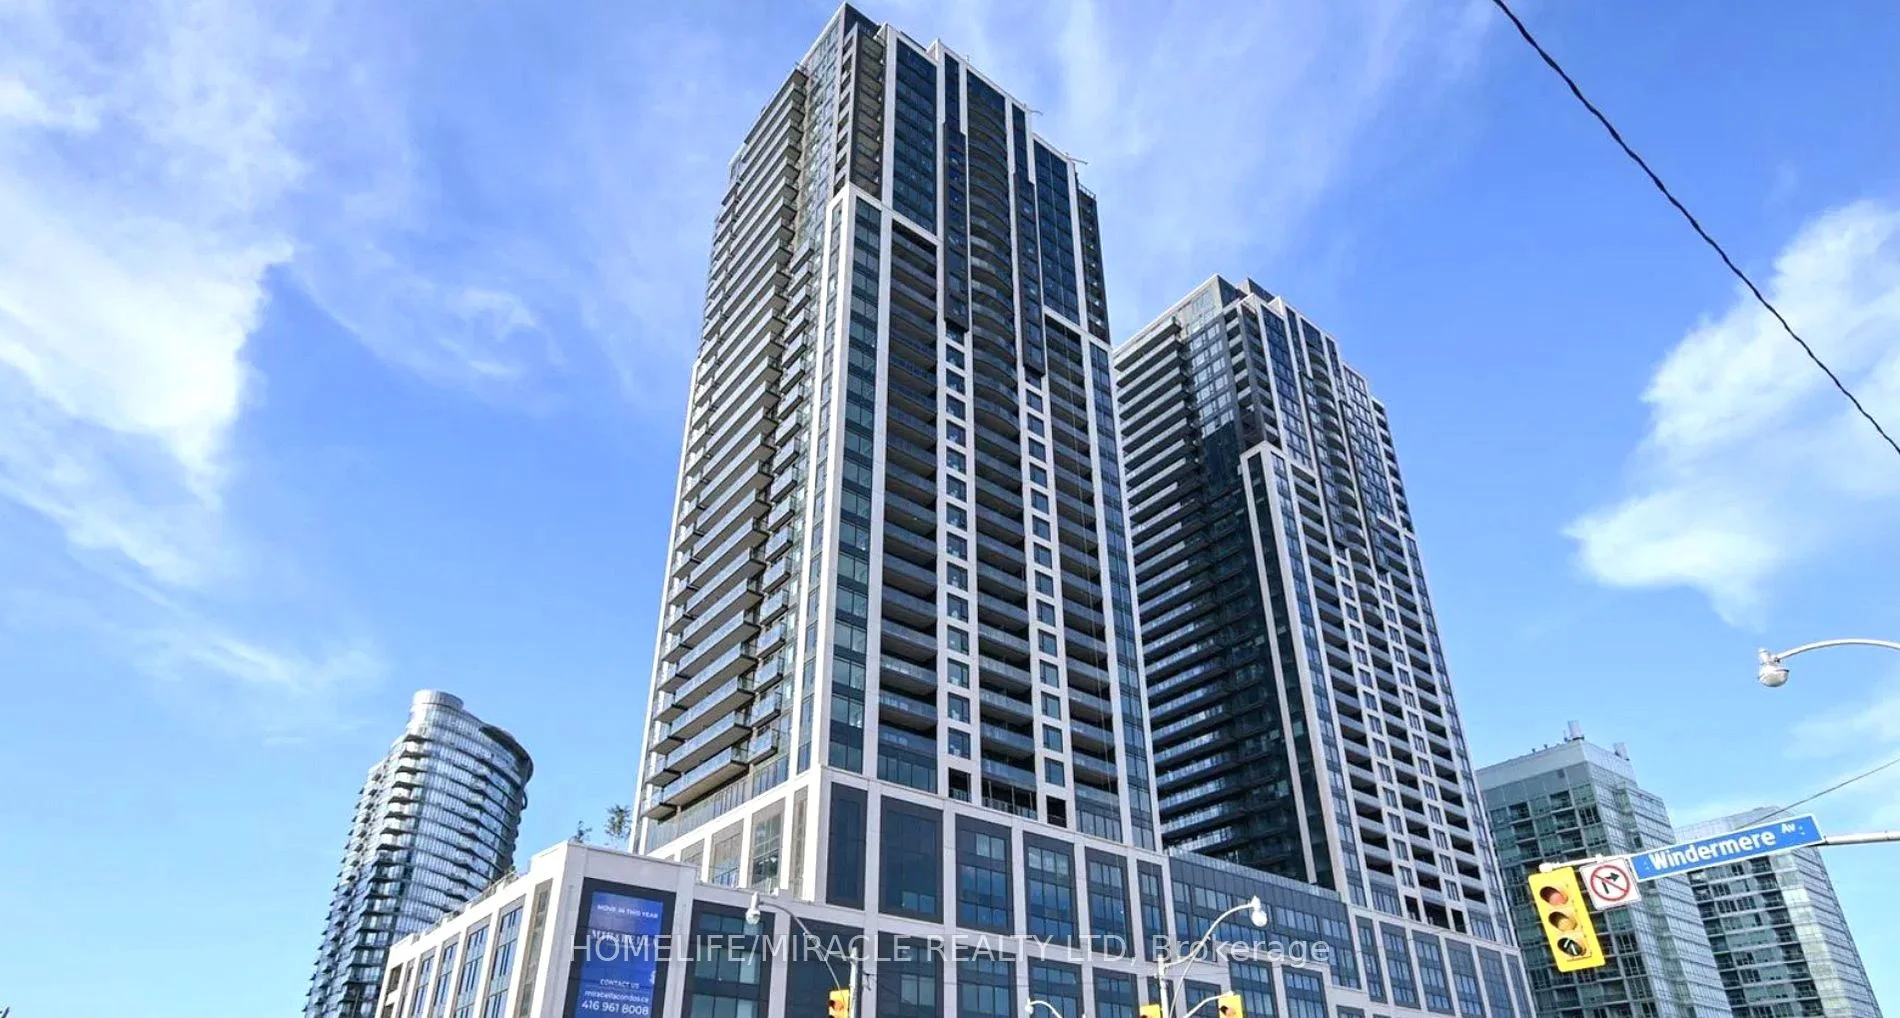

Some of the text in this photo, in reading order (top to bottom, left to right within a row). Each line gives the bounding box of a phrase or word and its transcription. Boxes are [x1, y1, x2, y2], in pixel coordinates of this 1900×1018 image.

[1649, 823, 1796, 870] Windermere Av
[600, 978, 630, 987] CONTACT
[582, 1000, 649, 1015] 416 961 8008
